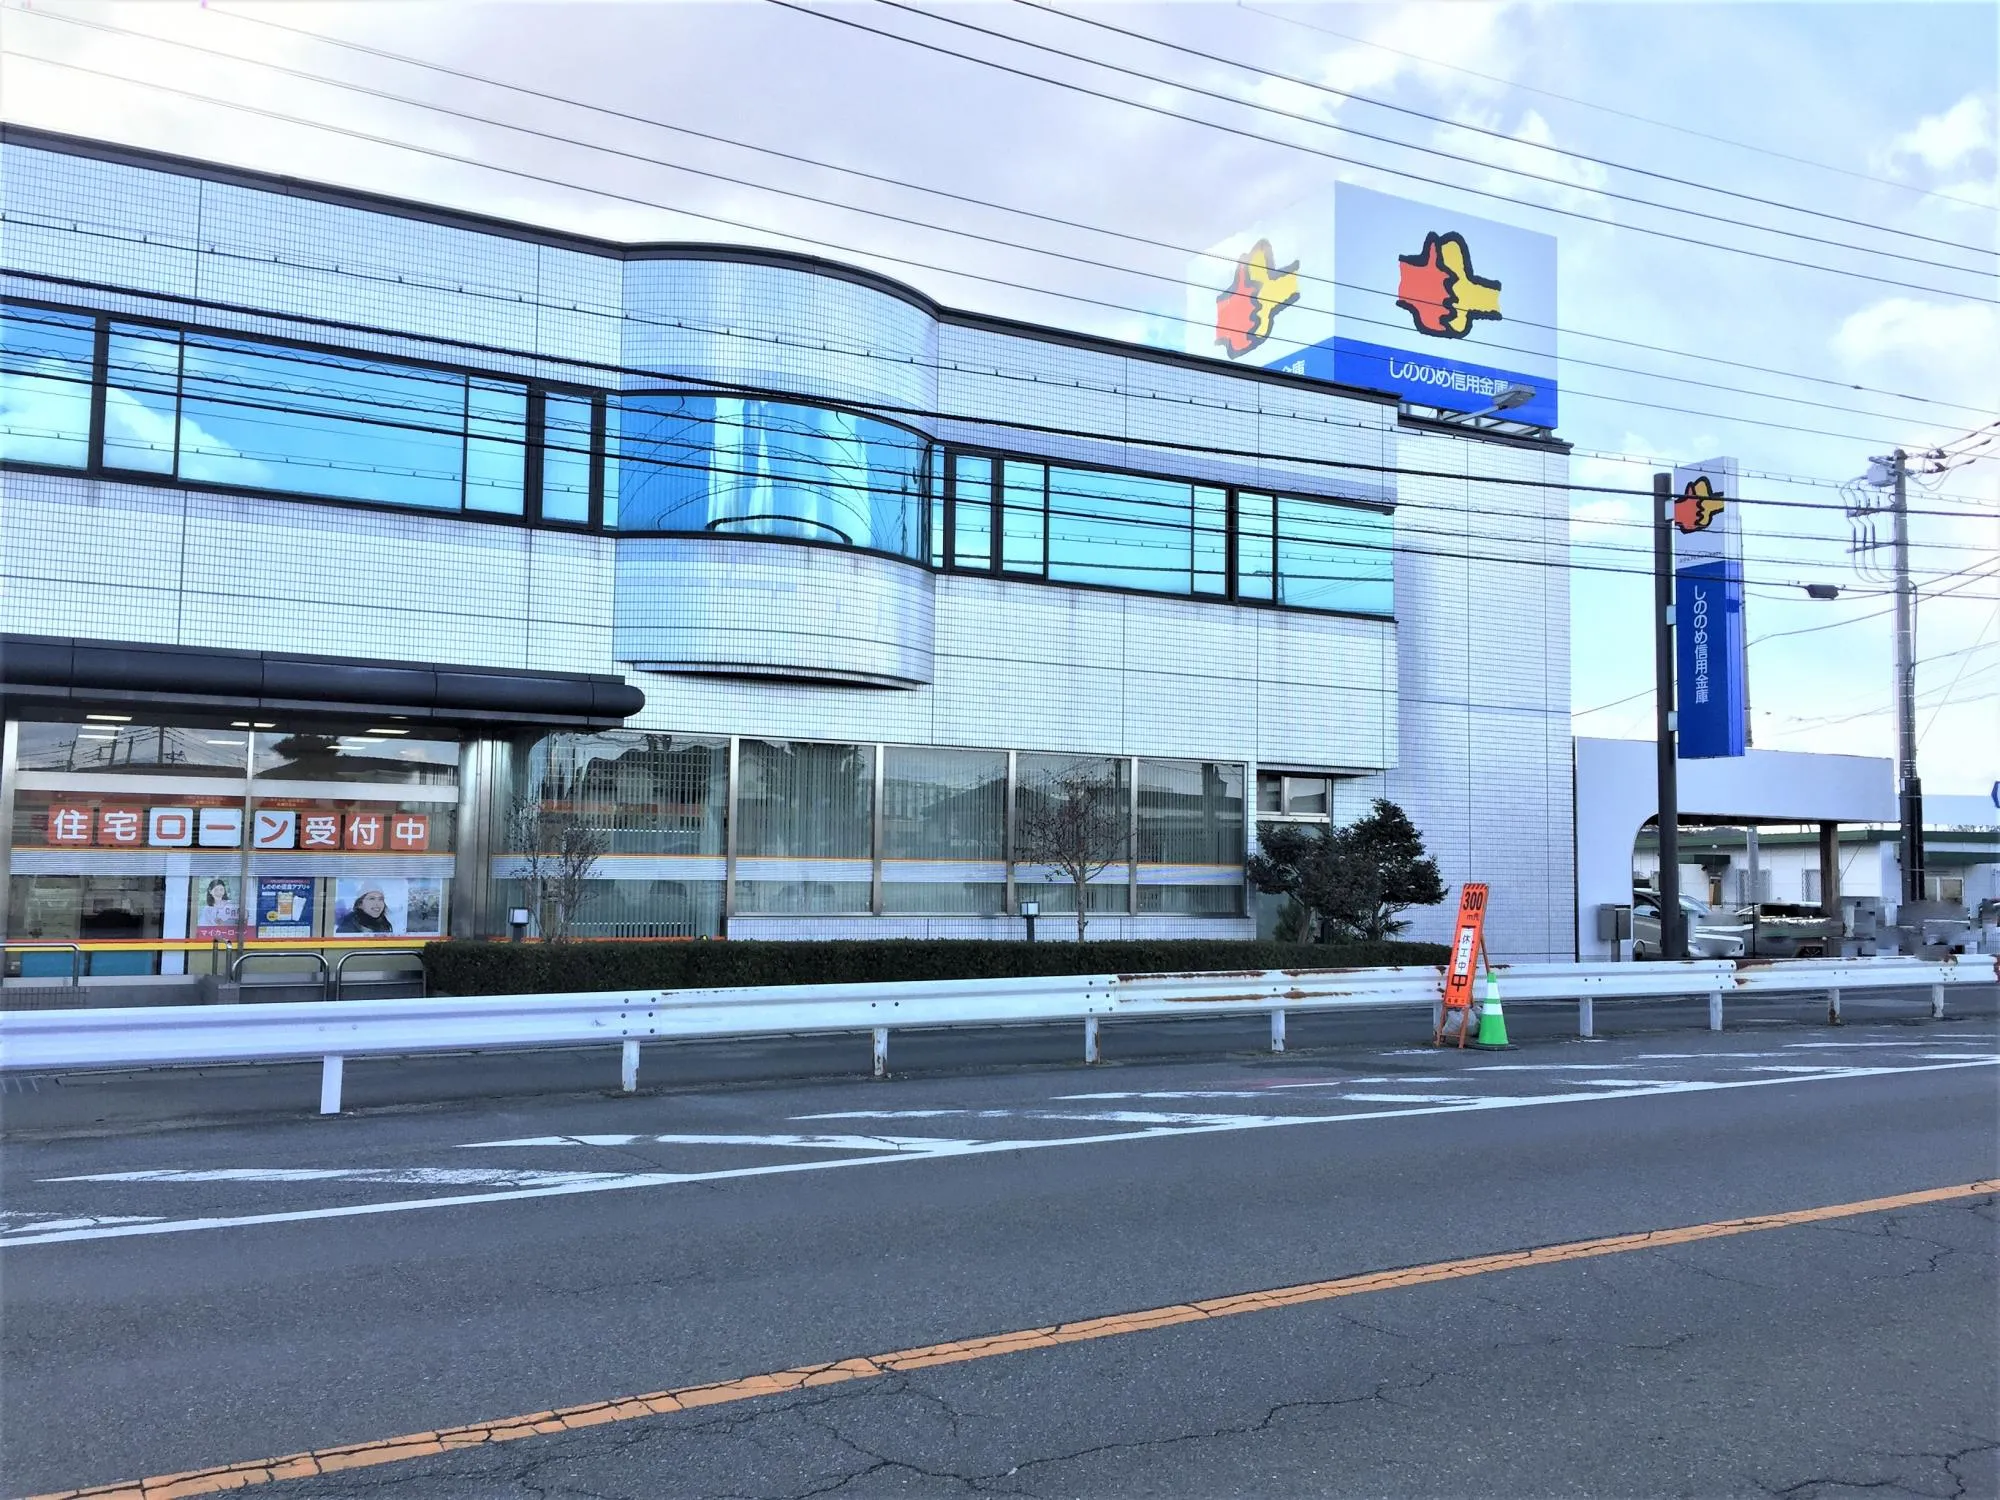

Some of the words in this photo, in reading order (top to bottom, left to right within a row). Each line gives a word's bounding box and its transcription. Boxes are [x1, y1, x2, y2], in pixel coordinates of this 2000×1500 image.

[1693, 585, 1709, 704] しののめ信用金庫
[53, 809, 425, 846] 住宅ローン受付中
[1463, 891, 1484, 911] 300
